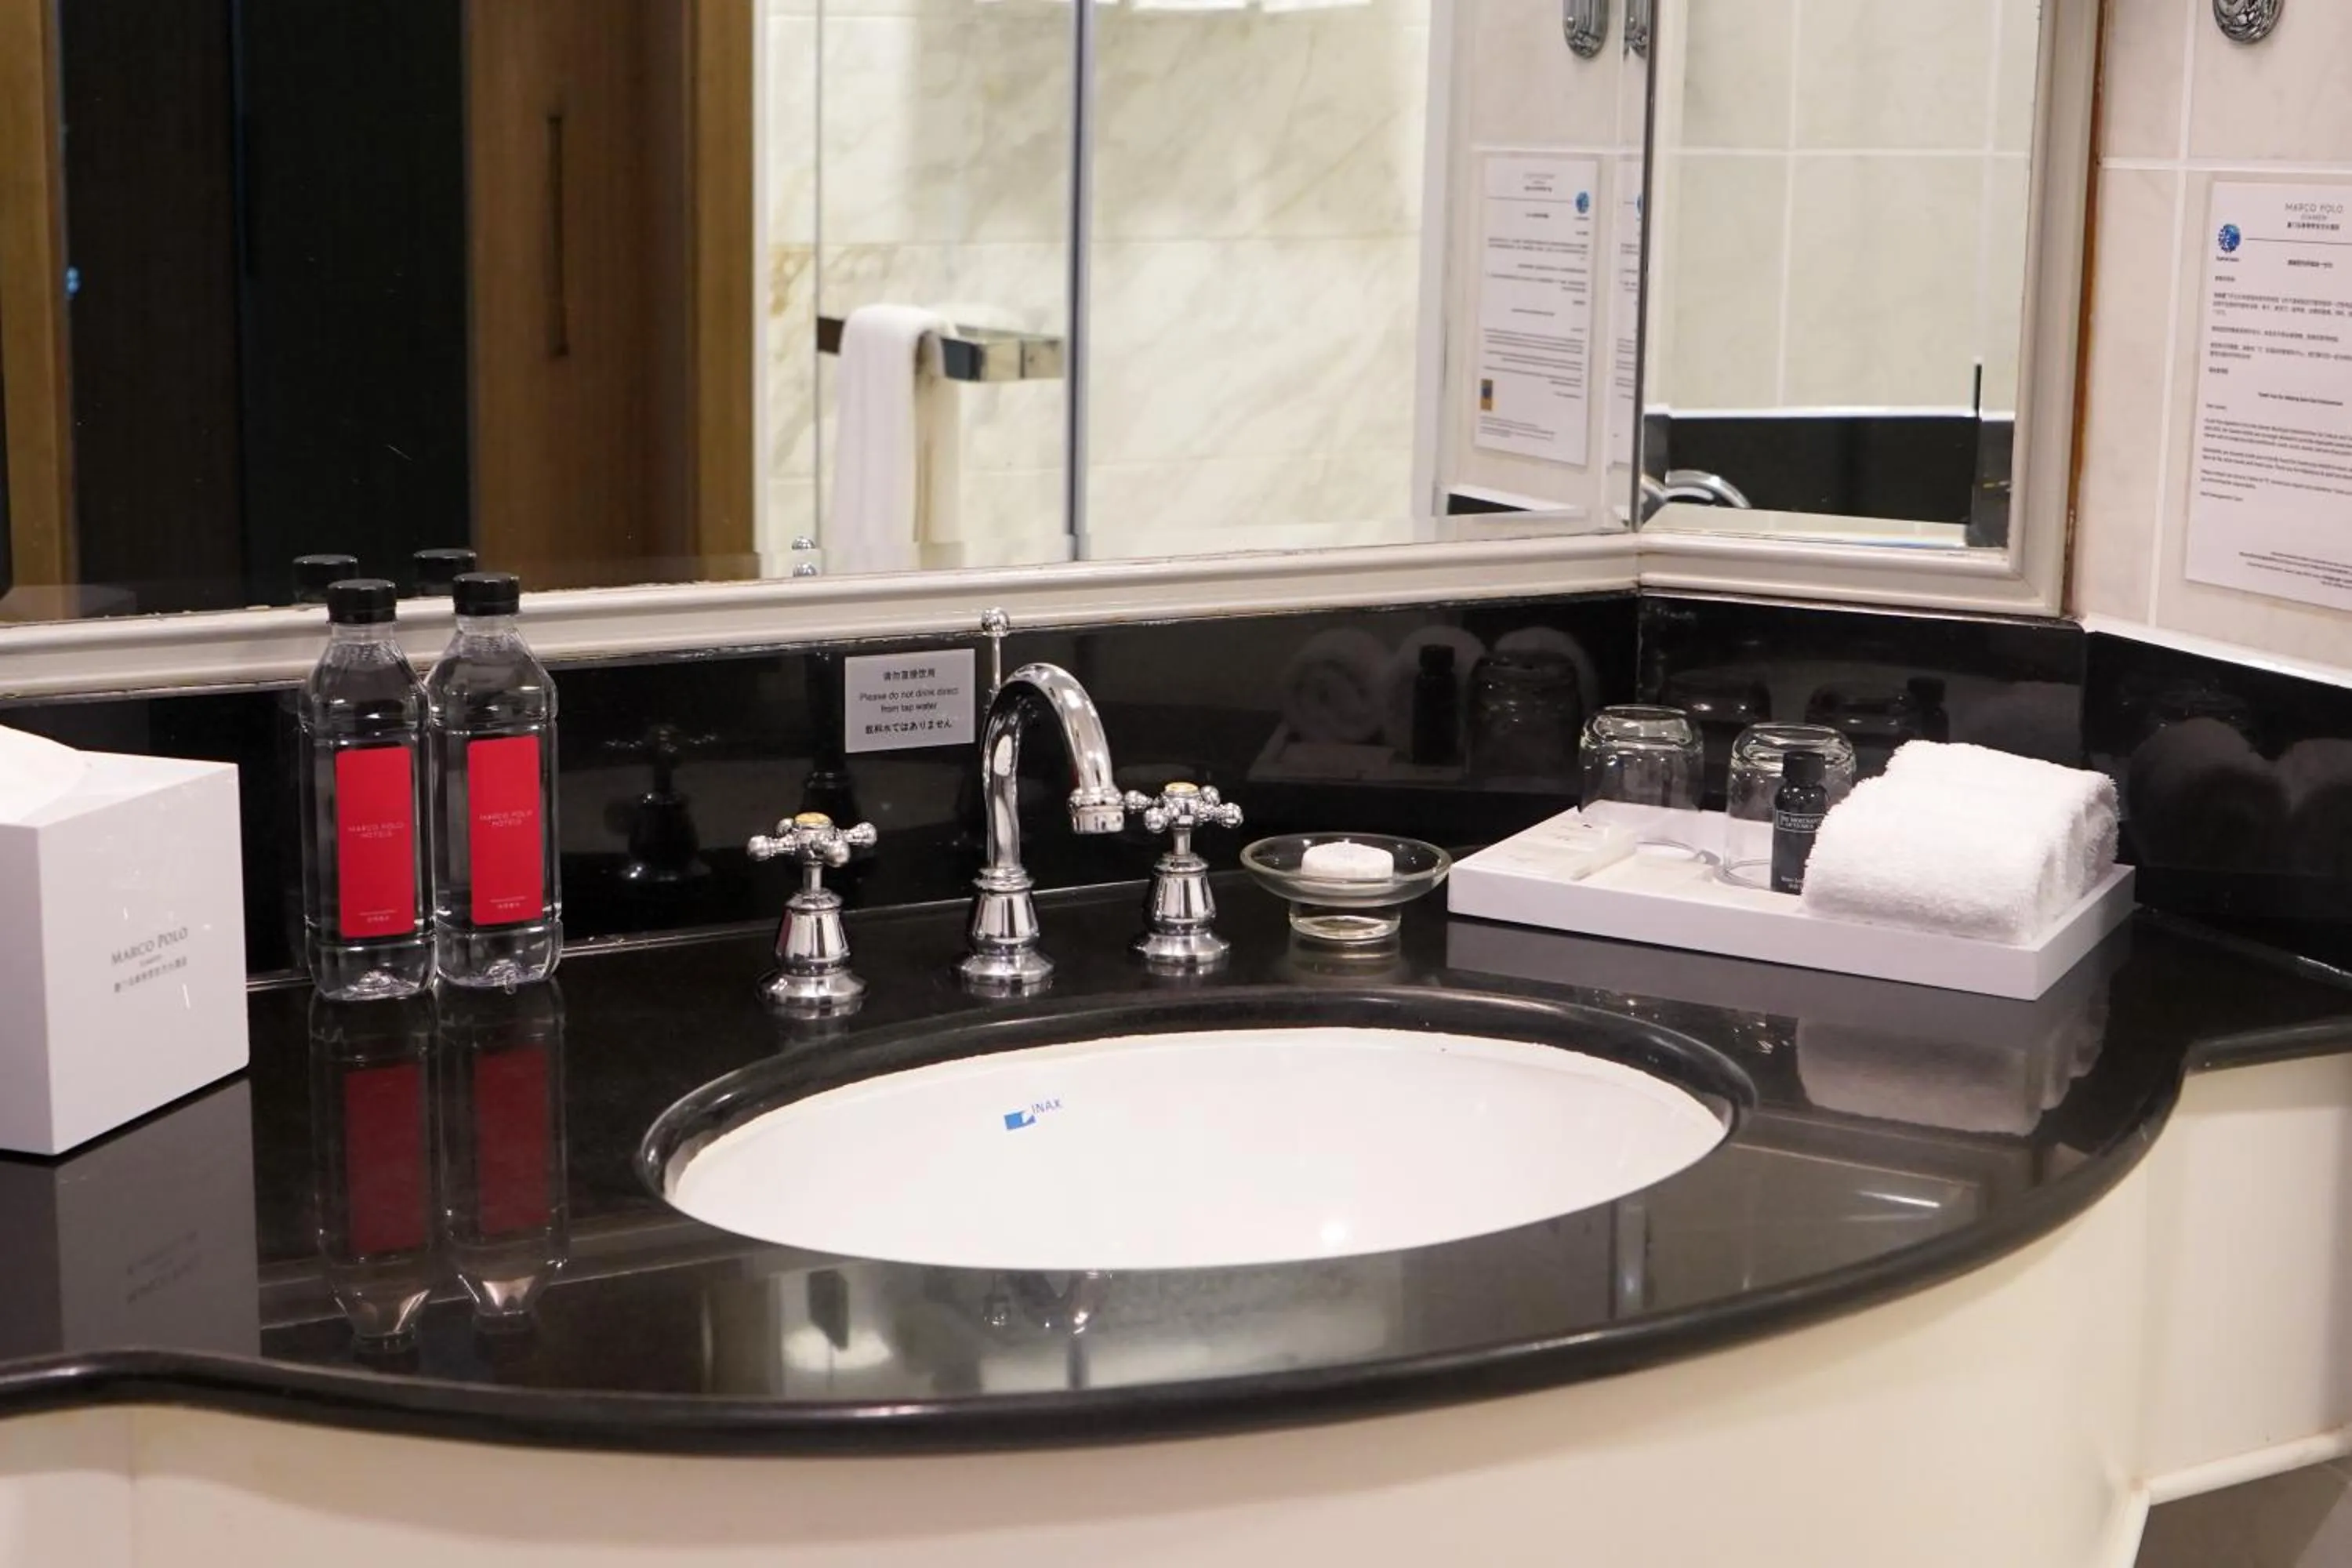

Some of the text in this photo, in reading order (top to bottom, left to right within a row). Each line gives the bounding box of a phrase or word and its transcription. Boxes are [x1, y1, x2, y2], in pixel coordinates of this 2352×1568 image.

[2285, 203, 2343, 215] MARCO POLO
[859, 691, 887, 701] Please
[888, 691, 899, 700] do
[901, 690, 913, 699] not
[916, 689, 935, 698] drink
[880, 702, 937, 713] from tap water
[111, 940, 155, 965] MARCO
[158, 927, 188, 949] POLO
[1031, 1099, 1062, 1113] INAX
